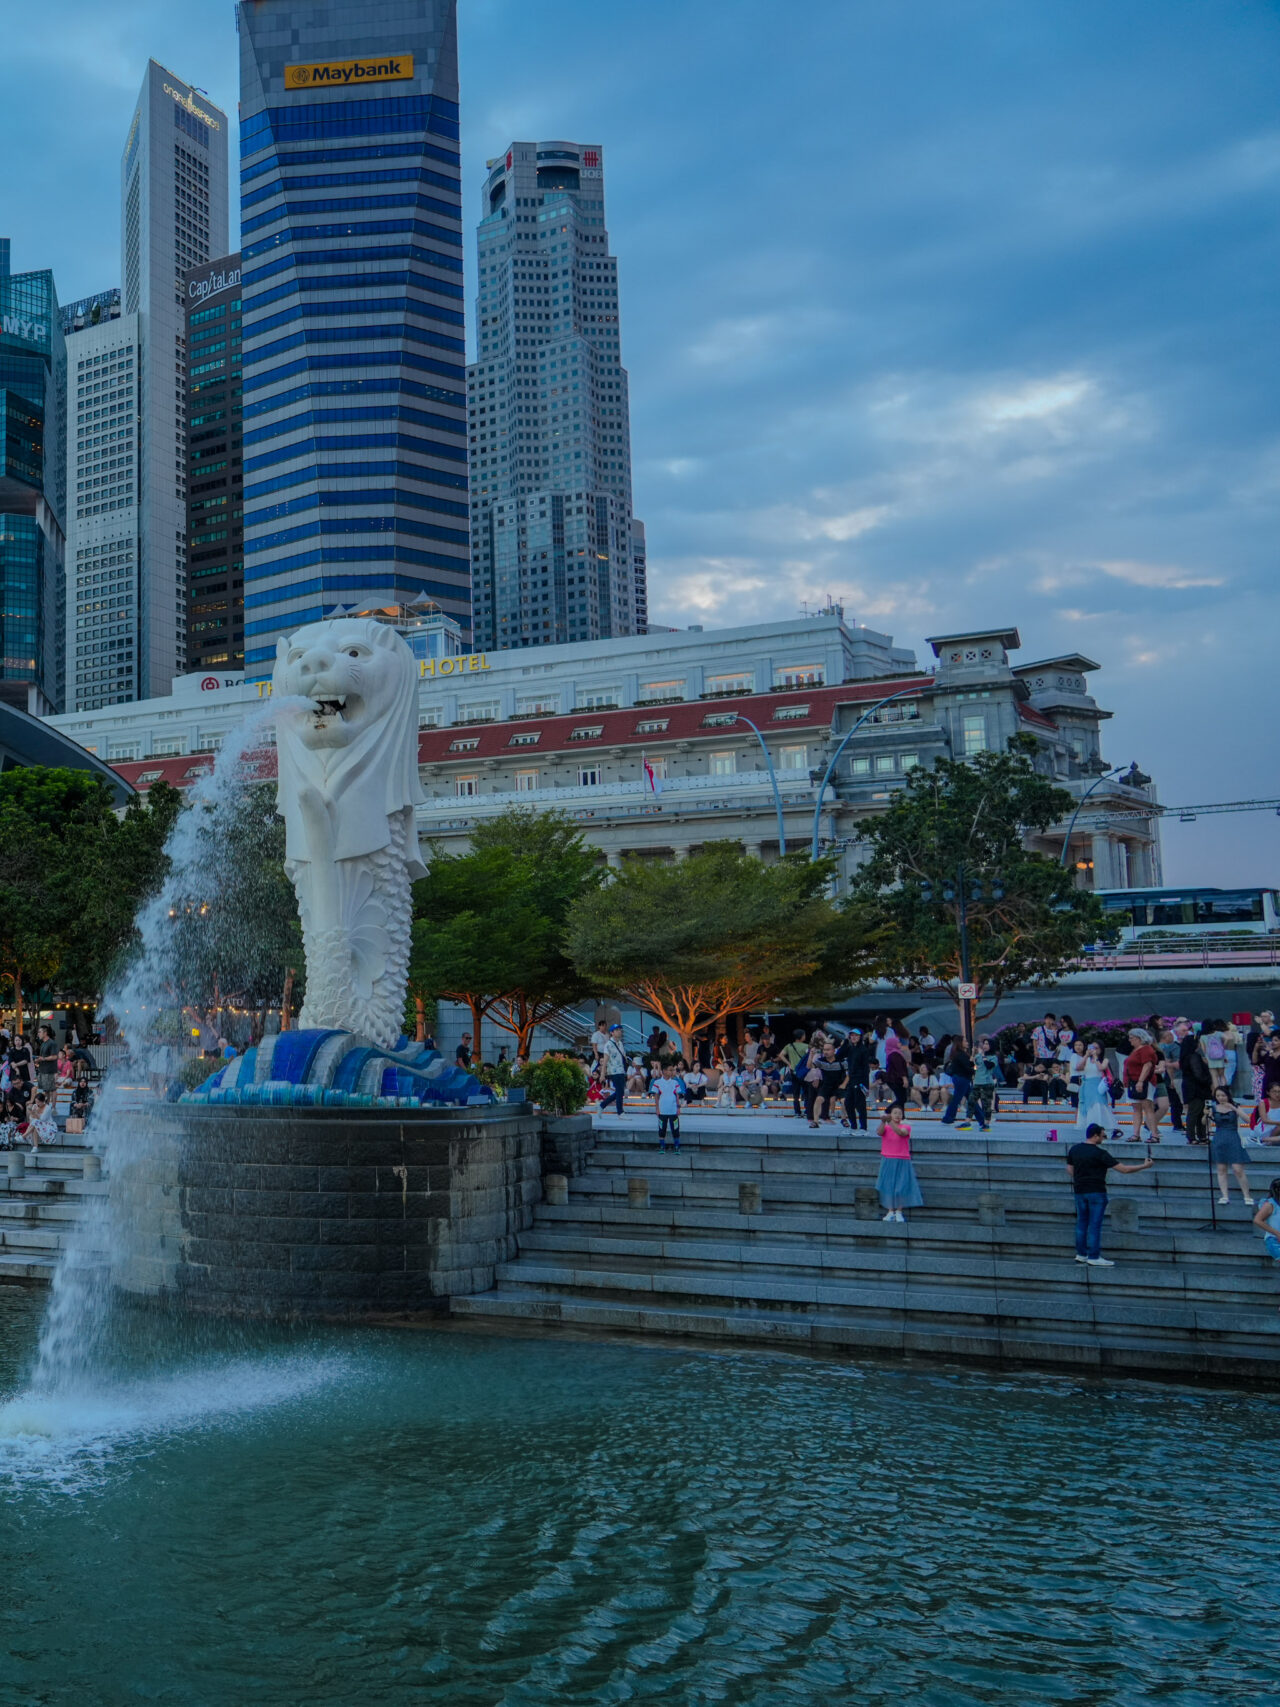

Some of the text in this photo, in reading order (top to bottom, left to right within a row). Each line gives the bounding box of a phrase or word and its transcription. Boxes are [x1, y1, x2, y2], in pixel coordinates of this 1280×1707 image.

[312, 60, 401, 82] Maybank
[580, 169, 602, 179] UOB
[189, 269, 240, 298] CapitaLan
[3, 315, 46, 341] MYP
[420, 654, 490, 677] HOTEL
